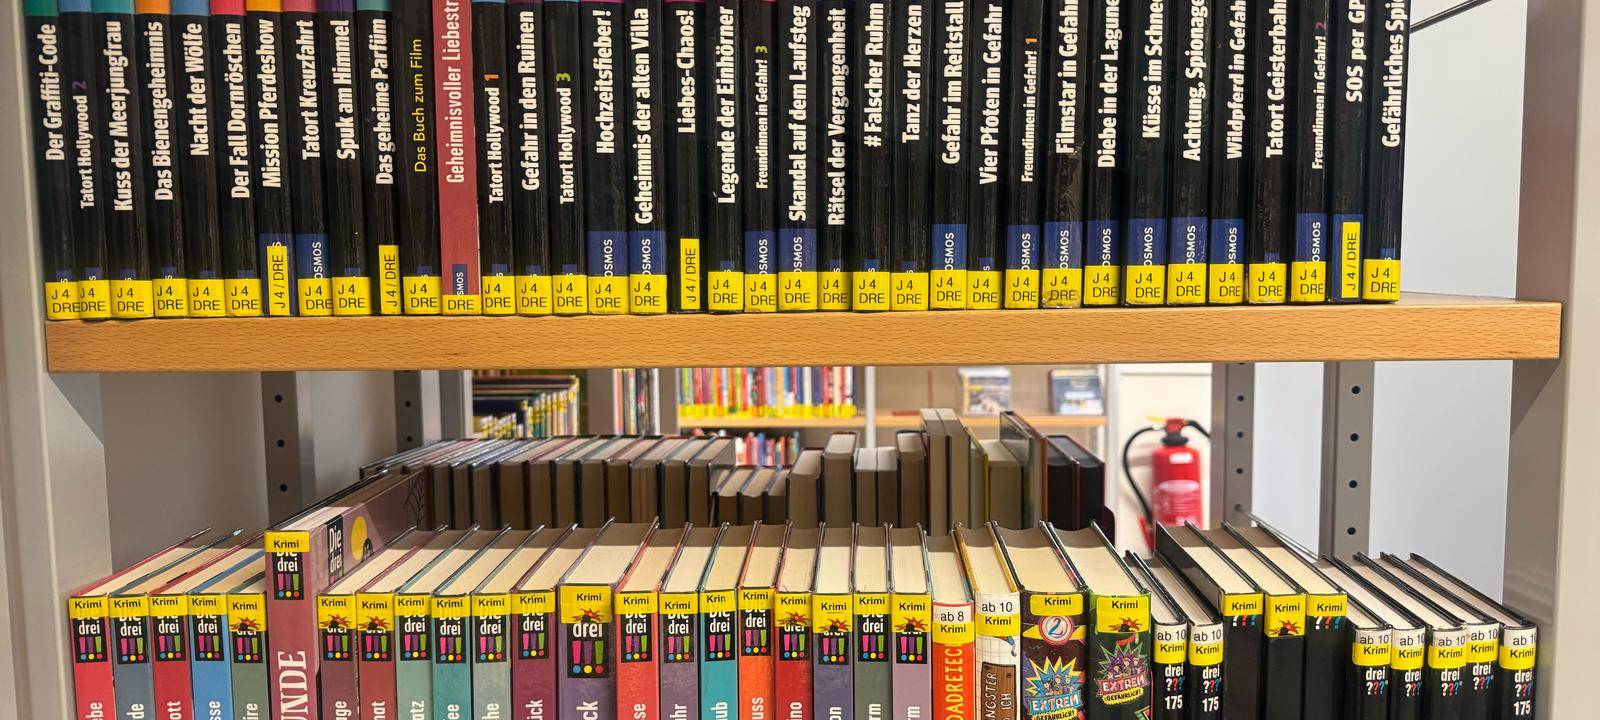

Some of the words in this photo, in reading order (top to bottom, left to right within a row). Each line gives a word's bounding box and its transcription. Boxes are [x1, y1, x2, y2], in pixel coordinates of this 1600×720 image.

[630, 8, 649, 50] Villa
[865, 3, 884, 55] Ruhm
[1144, 0, 1164, 56] Schne
[1316, 22, 1326, 30] 2
[1385, 0, 1408, 31] Spi
[182, 23, 204, 72] Wölfe
[330, 20, 352, 84] Himmel
[370, 19, 388, 79] Parfüm
[516, 12, 535, 73] Ruinen
[715, 6, 734, 94] Einhörner
[789, 6, 810, 80] Laufsteg
[903, 5, 922, 66] Herzen
[944, 1, 964, 77] Reitstall
[983, 4, 1002, 64] Gefahr
[1352, 29, 1366, 60] per
[256, 19, 278, 119] Pferdeshow
[296, 20, 317, 107] Kreuzfahrt
[410, 40, 422, 68] Film
[676, 10, 695, 133] Liebes-Chaos!
[827, 8, 849, 136] Vergangenheit
[1057, 60, 1077, 77] in
[1143, 60, 1162, 81] im
[1228, 54, 1244, 70] in
[1314, 36, 1326, 80] Gefahr!
[37, 24, 62, 128] Graffiti-Code
[72, 80, 88, 89] 2
[104, 22, 129, 136] Meerjungfrau
[187, 76, 206, 104] der
[223, 23, 246, 131] Dornröschen
[414, 74, 424, 102] zum
[556, 73, 570, 81] 3
[593, 10, 614, 153] Hochzeitsfieber!
[632, 53, 650, 98] alten
[755, 59, 768, 102] Gefahr!
[902, 70, 920, 100] der
[982, 67, 1000, 84] in
[1024, 51, 1037, 94] Gefahr!
[1100, 64, 1118, 94] der
[1313, 82, 1325, 94] in
[1346, 66, 1363, 102] SOS
[1382, 34, 1404, 147] Gefährliches
[144, 22, 171, 166] Bienengeheimnis
[338, 88, 353, 113] am
[519, 77, 537, 109] den
[755, 104, 768, 115] in
[789, 84, 806, 120] dem
[864, 59, 883, 132] Falscher
[942, 81, 962, 102] im
[1023, 96, 1036, 107] in
[1098, 97, 1117, 114] in
[372, 82, 395, 152] geheime
[412, 108, 425, 141] Buch
[443, 66, 464, 182] Geheimnisvoller
[485, 88, 503, 160] Hollywood
[519, 113, 537, 129] in
[556, 88, 575, 160] Hollywood
[633, 102, 651, 131] der
[716, 98, 734, 128] der
[902, 104, 920, 143] Tanz
[980, 88, 1000, 145] Pfoten
[1055, 80, 1077, 155] Filmstar
[1142, 85, 1161, 138] Küsse
[1183, 82, 1206, 161] Achtung,
[1226, 74, 1245, 159] Wildpferd
[46, 132, 64, 160] Der
[73, 95, 93, 166] Hollywood
[188, 108, 209, 155] Nacht
[301, 111, 320, 160] Tatort
[335, 116, 356, 159] Spuk
[788, 123, 806, 151] auf
[864, 135, 881, 147] #
[942, 106, 961, 164] Gefahr
[1021, 110, 1035, 182] Freundinnen
[1097, 117, 1116, 167] Diebe
[1266, 104, 1284, 158] Tatort
[1312, 95, 1324, 169] Freundinnen
[111, 140, 130, 168] der
[228, 135, 248, 165] Fall
[260, 123, 281, 187] Mission
[414, 146, 426, 172] Das
[520, 132, 540, 190] Gefahr
[716, 131, 739, 203] Legende
[755, 117, 768, 188] Freundinnen
[828, 140, 845, 168] der
[979, 148, 998, 184] Vier
[155, 170, 173, 200] Das
[231, 169, 250, 198] Der
[376, 154, 393, 184] Das
[488, 163, 503, 203] Tatort
[560, 163, 574, 204] Tatort
[633, 134, 653, 224] Geheimnis
[79, 168, 94, 208] Tatort
[114, 171, 132, 210] Kuss
[789, 154, 806, 221] Skandal
[828, 172, 845, 225] Rätsel
[312, 242, 322, 278] OSMOS
[1312, 222, 1320, 262] OSMOS
[1347, 234, 1356, 260] DRE
[595, 284, 601, 294] J
[605, 284, 612, 293] 4
[1371, 282, 1396, 293] DRE
[1372, 268, 1378, 278] J
[1383, 268, 1390, 278] 4
[117, 288, 122, 298] J
[127, 288, 133, 297] 4
[118, 301, 144, 311] DRE
[596, 298, 620, 308] DRE
[274, 540, 298, 548] Krimi
[330, 525, 342, 553] Die
[278, 557, 297, 571] drei
[523, 616, 543, 631] drei
[941, 612, 954, 622] ab
[958, 611, 964, 621] 8
[982, 602, 995, 612] ab
[1000, 602, 1012, 612] 10
[985, 616, 1011, 625] Krimi
[1232, 601, 1256, 610] Krimi
[79, 620, 100, 634] drei
[159, 620, 178, 633] drei
[710, 618, 730, 632] drei
[941, 625, 966, 633] Krimi
[1047, 617, 1064, 636] 2
[945, 644, 964, 720] ADREIEC
[1102, 675, 1145, 692] EXTREM
[1165, 664, 1183, 676] drei
[985, 672, 998, 720] NGSTER
[1001, 693, 1012, 710] ICH
[1032, 694, 1079, 711] EXTREM
[1165, 695, 1182, 709] 175
[1514, 700, 1530, 715] 175
